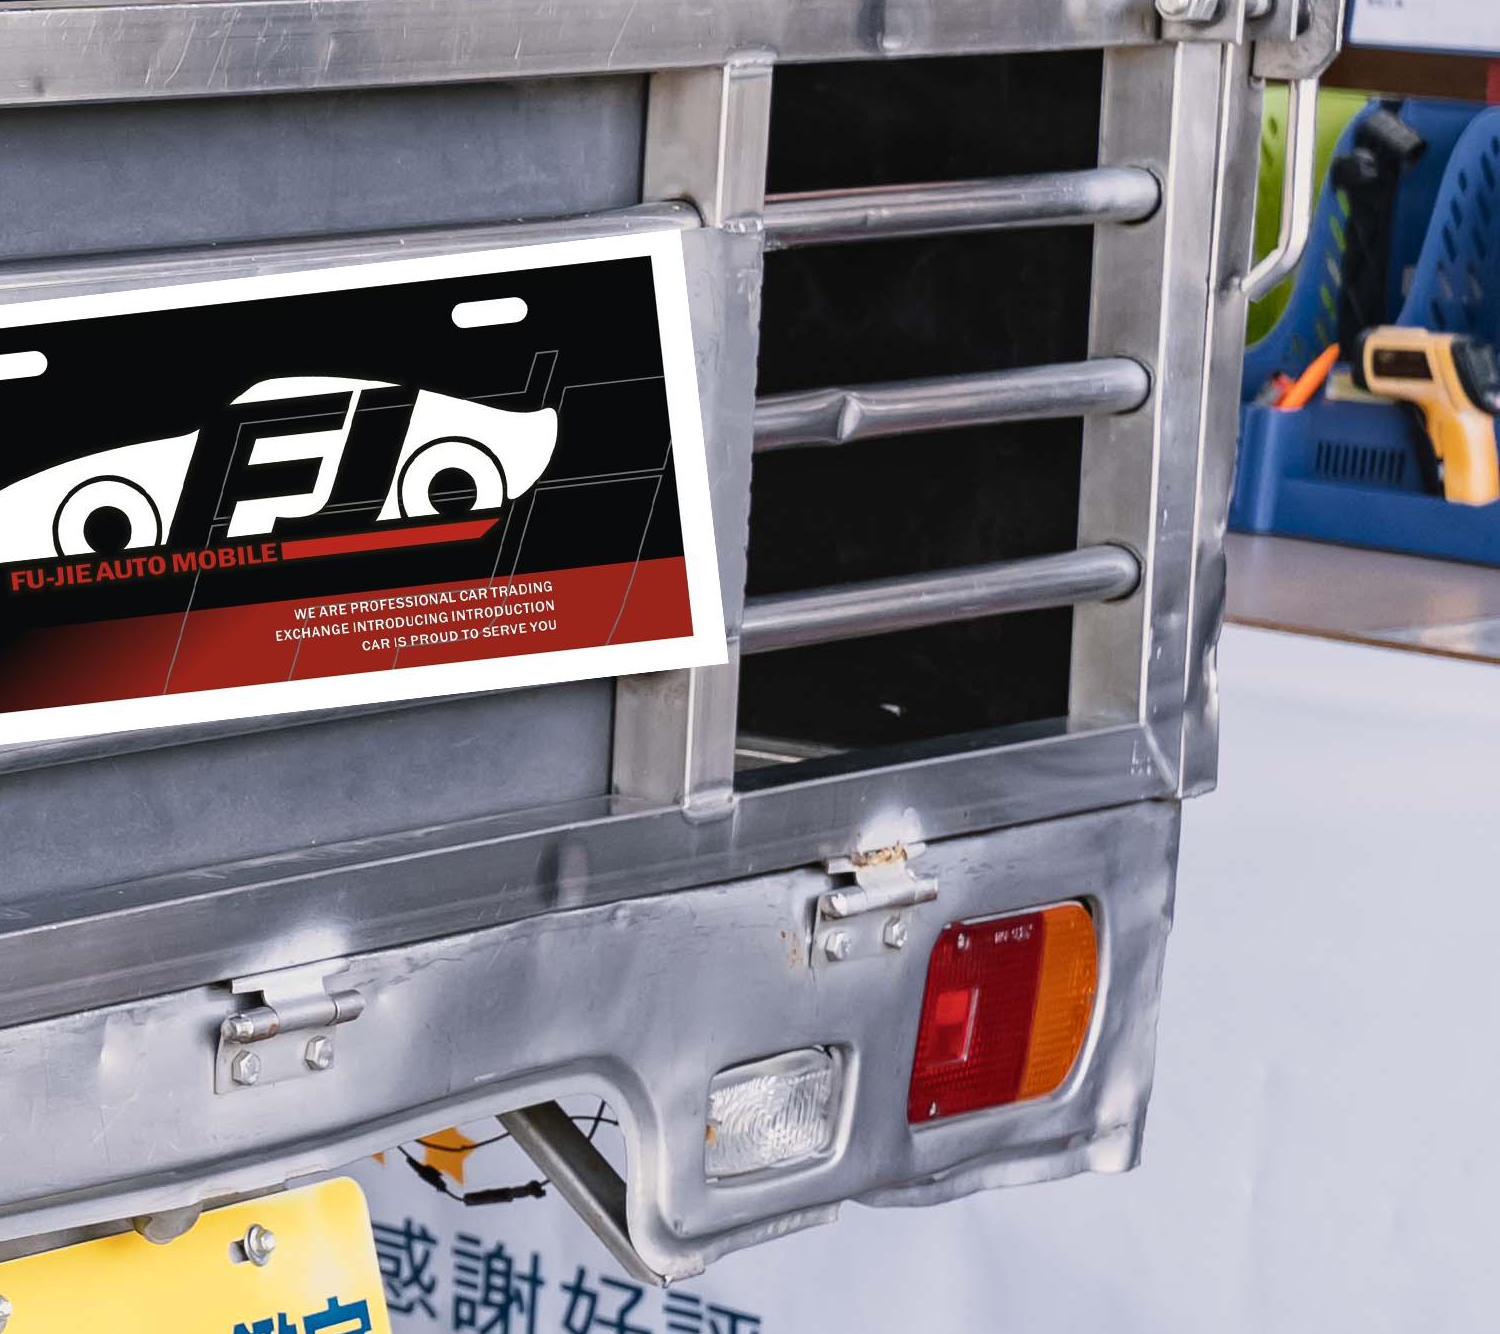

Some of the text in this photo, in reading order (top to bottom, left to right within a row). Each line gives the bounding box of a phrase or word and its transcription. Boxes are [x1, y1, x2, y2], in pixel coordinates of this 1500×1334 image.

[11, 543, 278, 591] FU-JIE AUTO MOBILE
[275, 599, 556, 642] EXCHANGE INTRODUCING INTRODUCTION
[294, 580, 553, 620] WE ARE PROFESSIONAL CAR TRADING
[361, 619, 558, 651] CAR IS PROUD TO SERVE YOU
